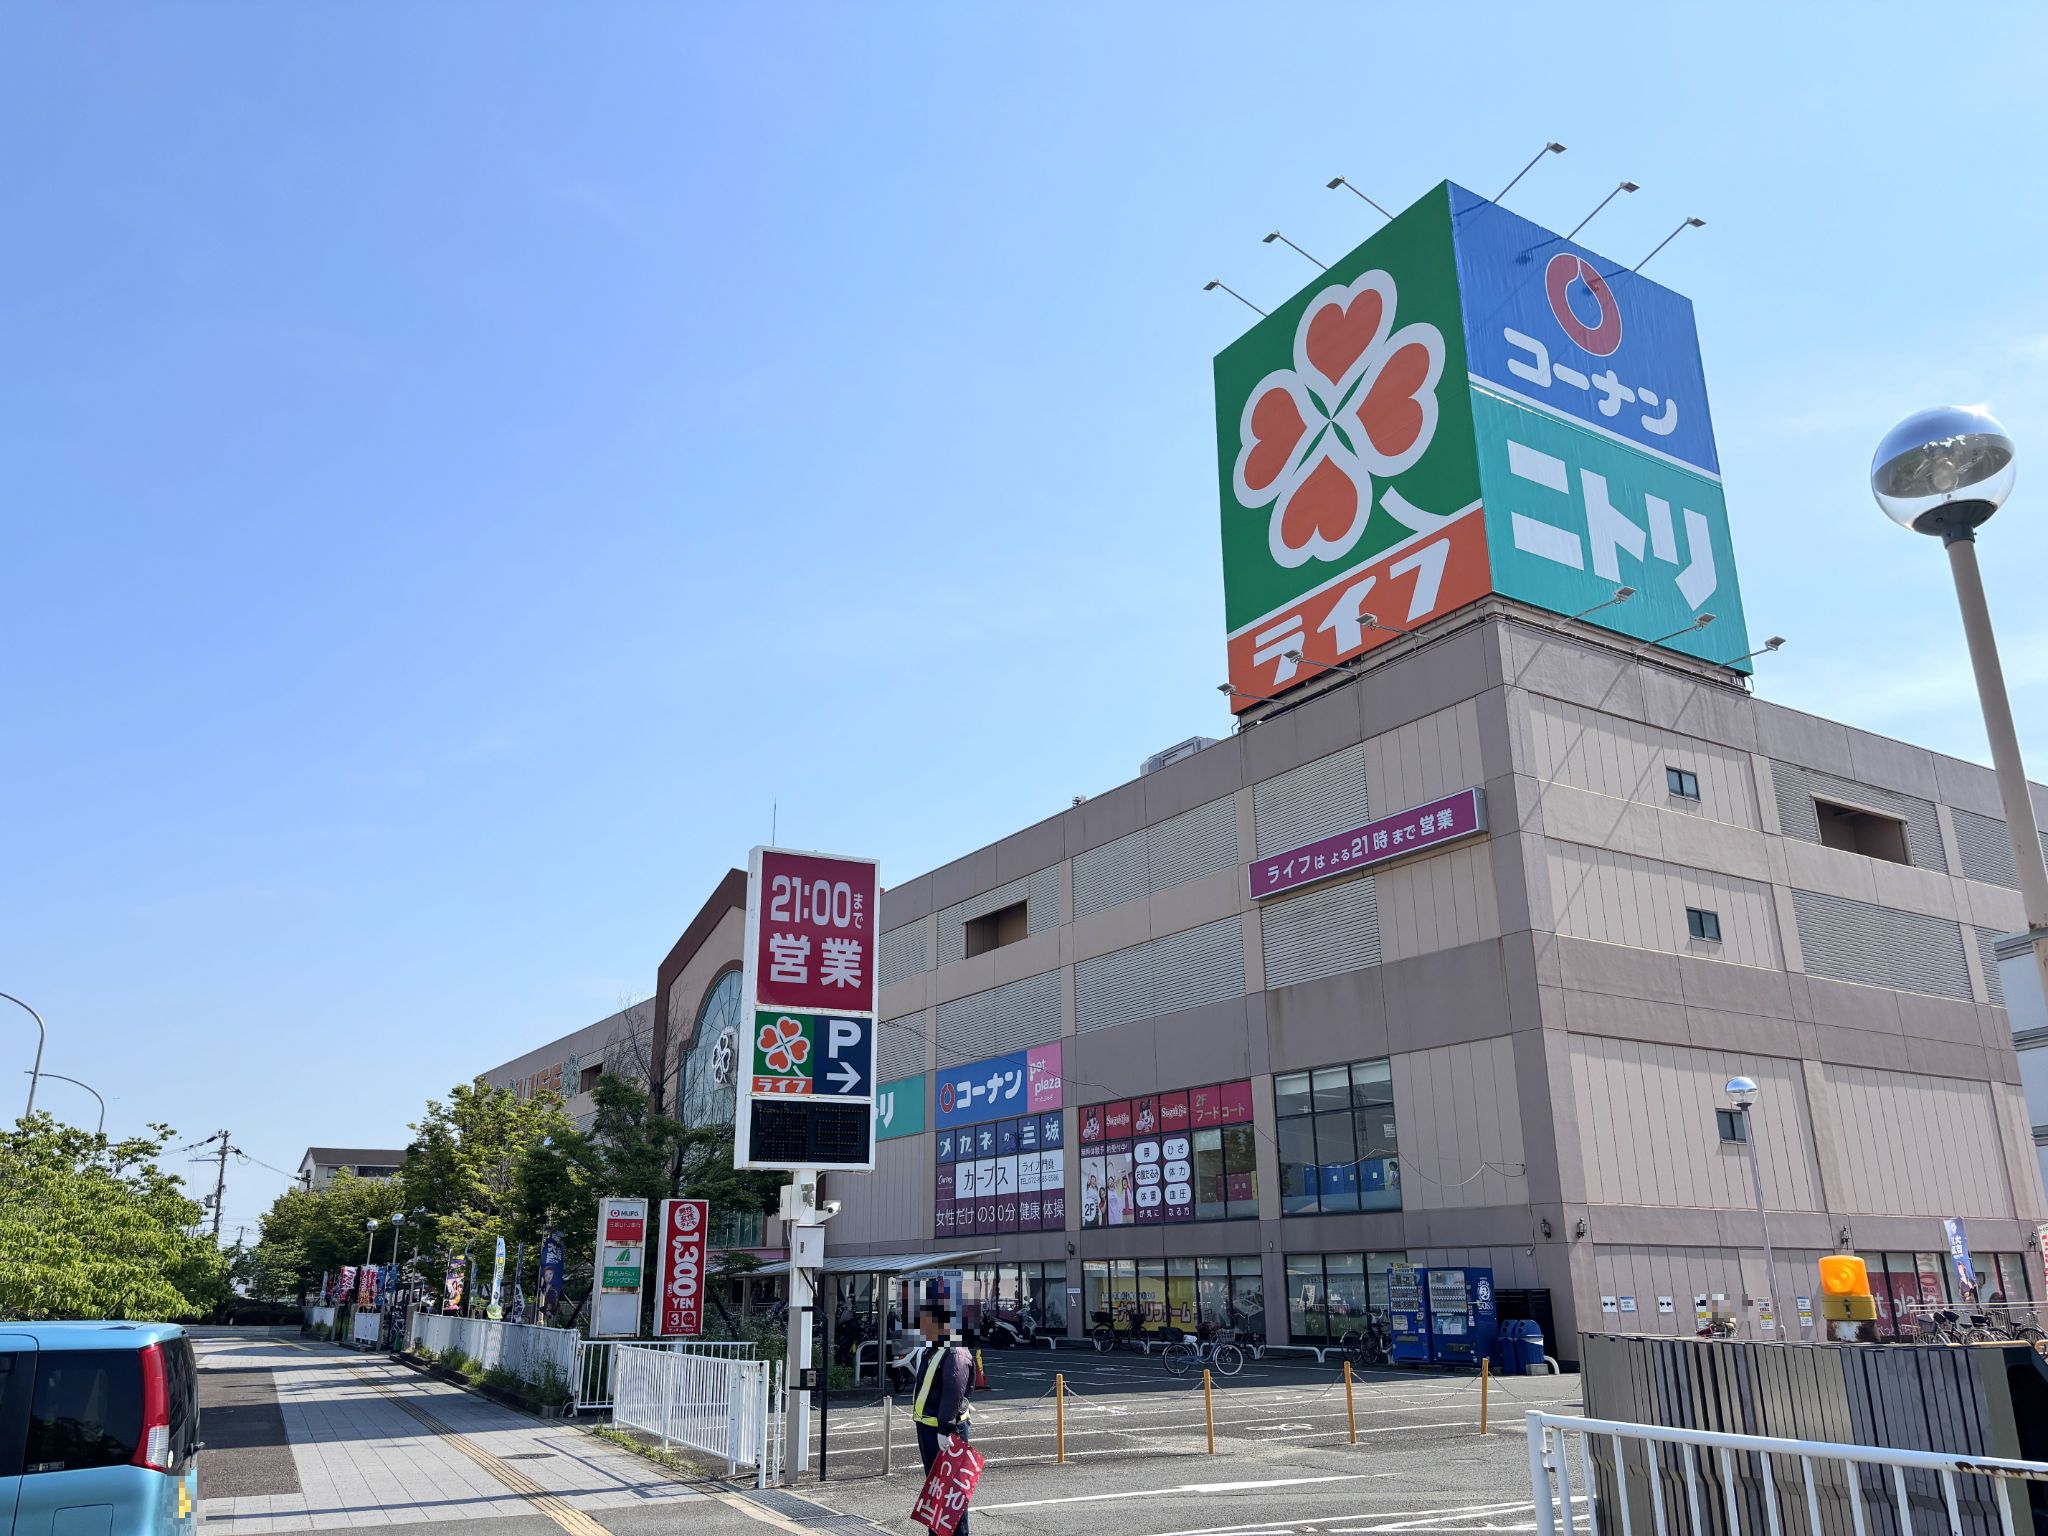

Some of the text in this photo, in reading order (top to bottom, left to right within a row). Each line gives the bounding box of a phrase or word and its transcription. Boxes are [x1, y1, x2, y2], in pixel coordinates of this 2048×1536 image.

[1503, 327, 1678, 436] コーナン
[1507, 439, 1718, 612] ニトリ
[1253, 538, 1451, 686] ライフ
[1267, 808, 1454, 885] ライフはよる21時まで営業
[769, 932, 863, 989] 営業
[828, 1019, 862, 1060] P
[1030, 1058, 1046, 1082] pet
[757, 1077, 807, 1093] ライフ
[956, 1068, 1022, 1110] コーナン
[1035, 1077, 1061, 1097] plaza
[1195, 1093, 1208, 1107] 2F
[1196, 1103, 1246, 1123] フードコート
[1167, 1143, 1184, 1156] ひざ
[1168, 1165, 1186, 1180] 体力
[1169, 1188, 1187, 1200] 血圧
[936, 1198, 1065, 1227] 女性だけの30分健康体操
[1084, 1202, 1095, 1218] 2F
[672, 1231, 700, 1297] 1,300
[672, 1297, 695, 1310] YEN
